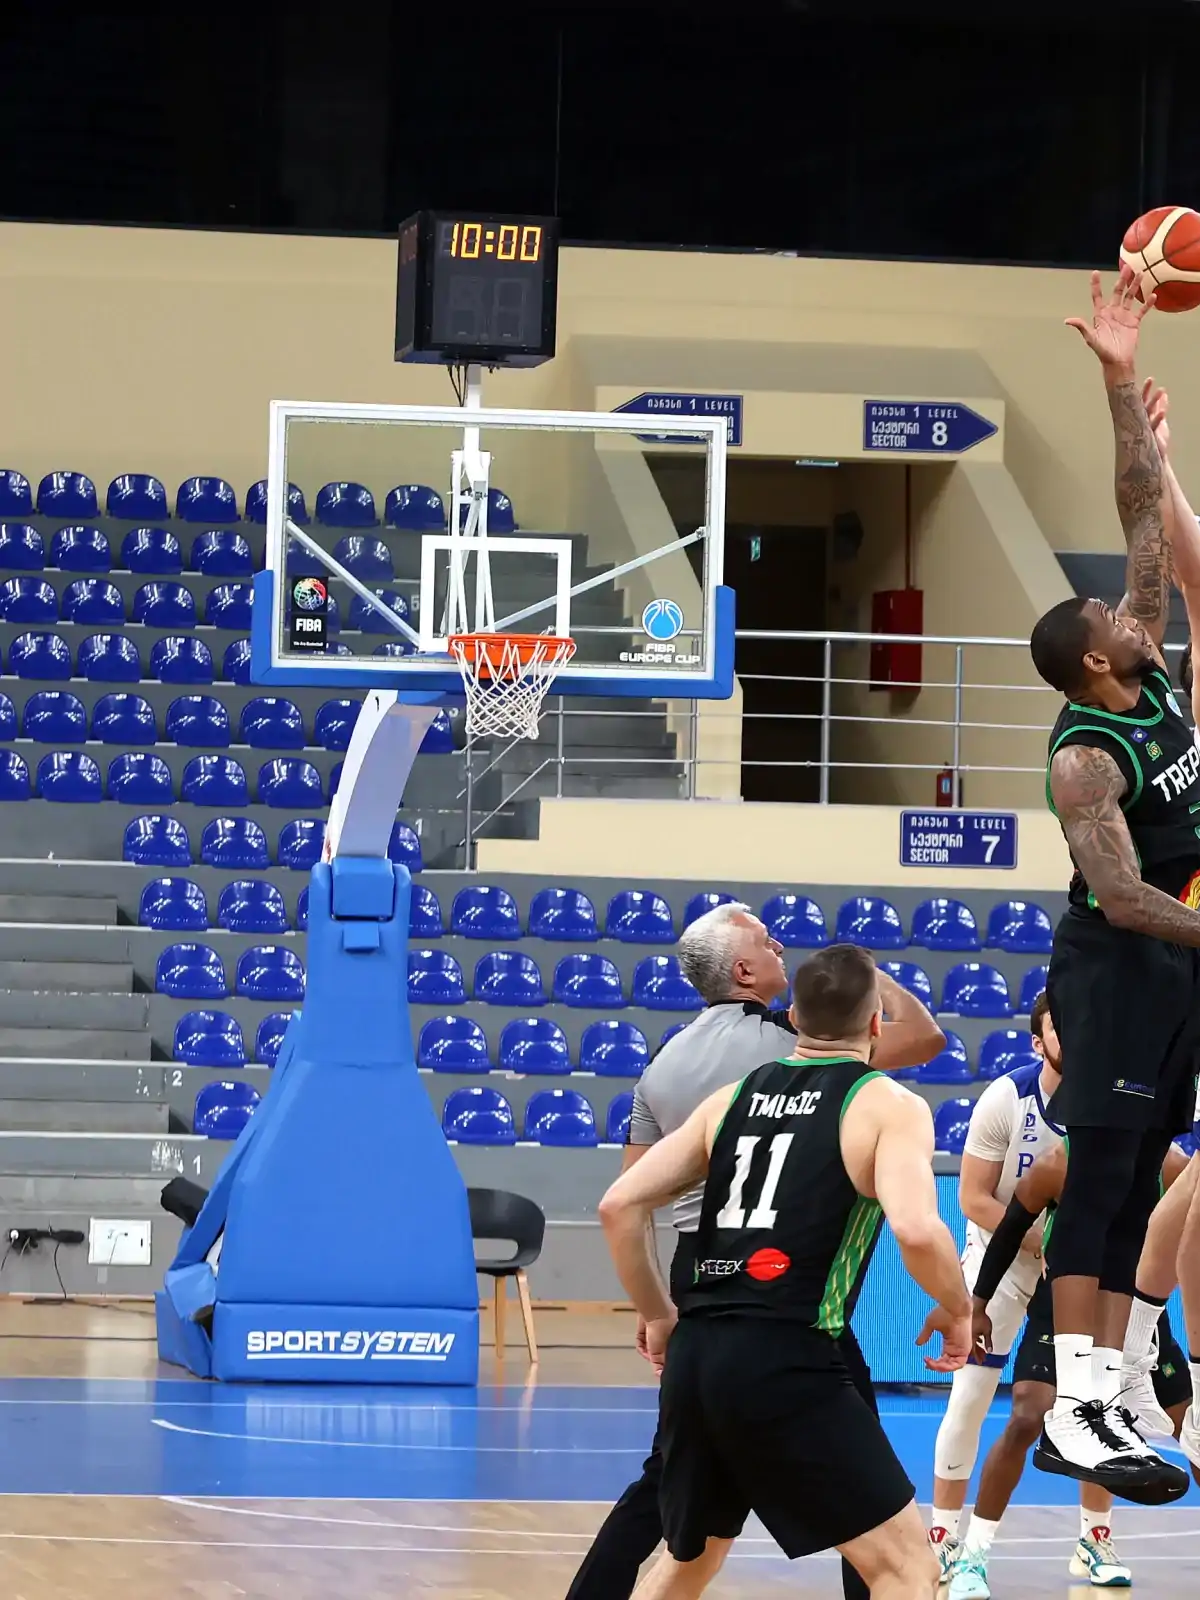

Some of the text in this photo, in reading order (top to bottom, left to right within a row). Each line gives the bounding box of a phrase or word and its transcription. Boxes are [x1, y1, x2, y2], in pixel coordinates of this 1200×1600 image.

[450, 223, 542, 261] 10:00
[689, 398, 696, 410] 1
[704, 400, 735, 411] LEVEL
[913, 406, 920, 418] 1
[928, 408, 958, 419] LEVEL
[871, 434, 907, 447] SECTOR
[931, 421, 948, 446] 8
[295, 618, 322, 632] FIBA
[645, 643, 676, 653] FIBA
[619, 652, 700, 664] EUROPE CUP
[1151, 745, 1200, 802] TREP
[957, 816, 965, 829] 1
[974, 818, 1007, 830] LEVEL
[910, 848, 949, 863] SECTOR
[981, 835, 1000, 864] 7
[172, 1070, 183, 1087] 2
[193, 1154, 201, 1175] 1
[717, 1133, 795, 1230] 11
[247, 1331, 455, 1358] SPORTSYSTEM
